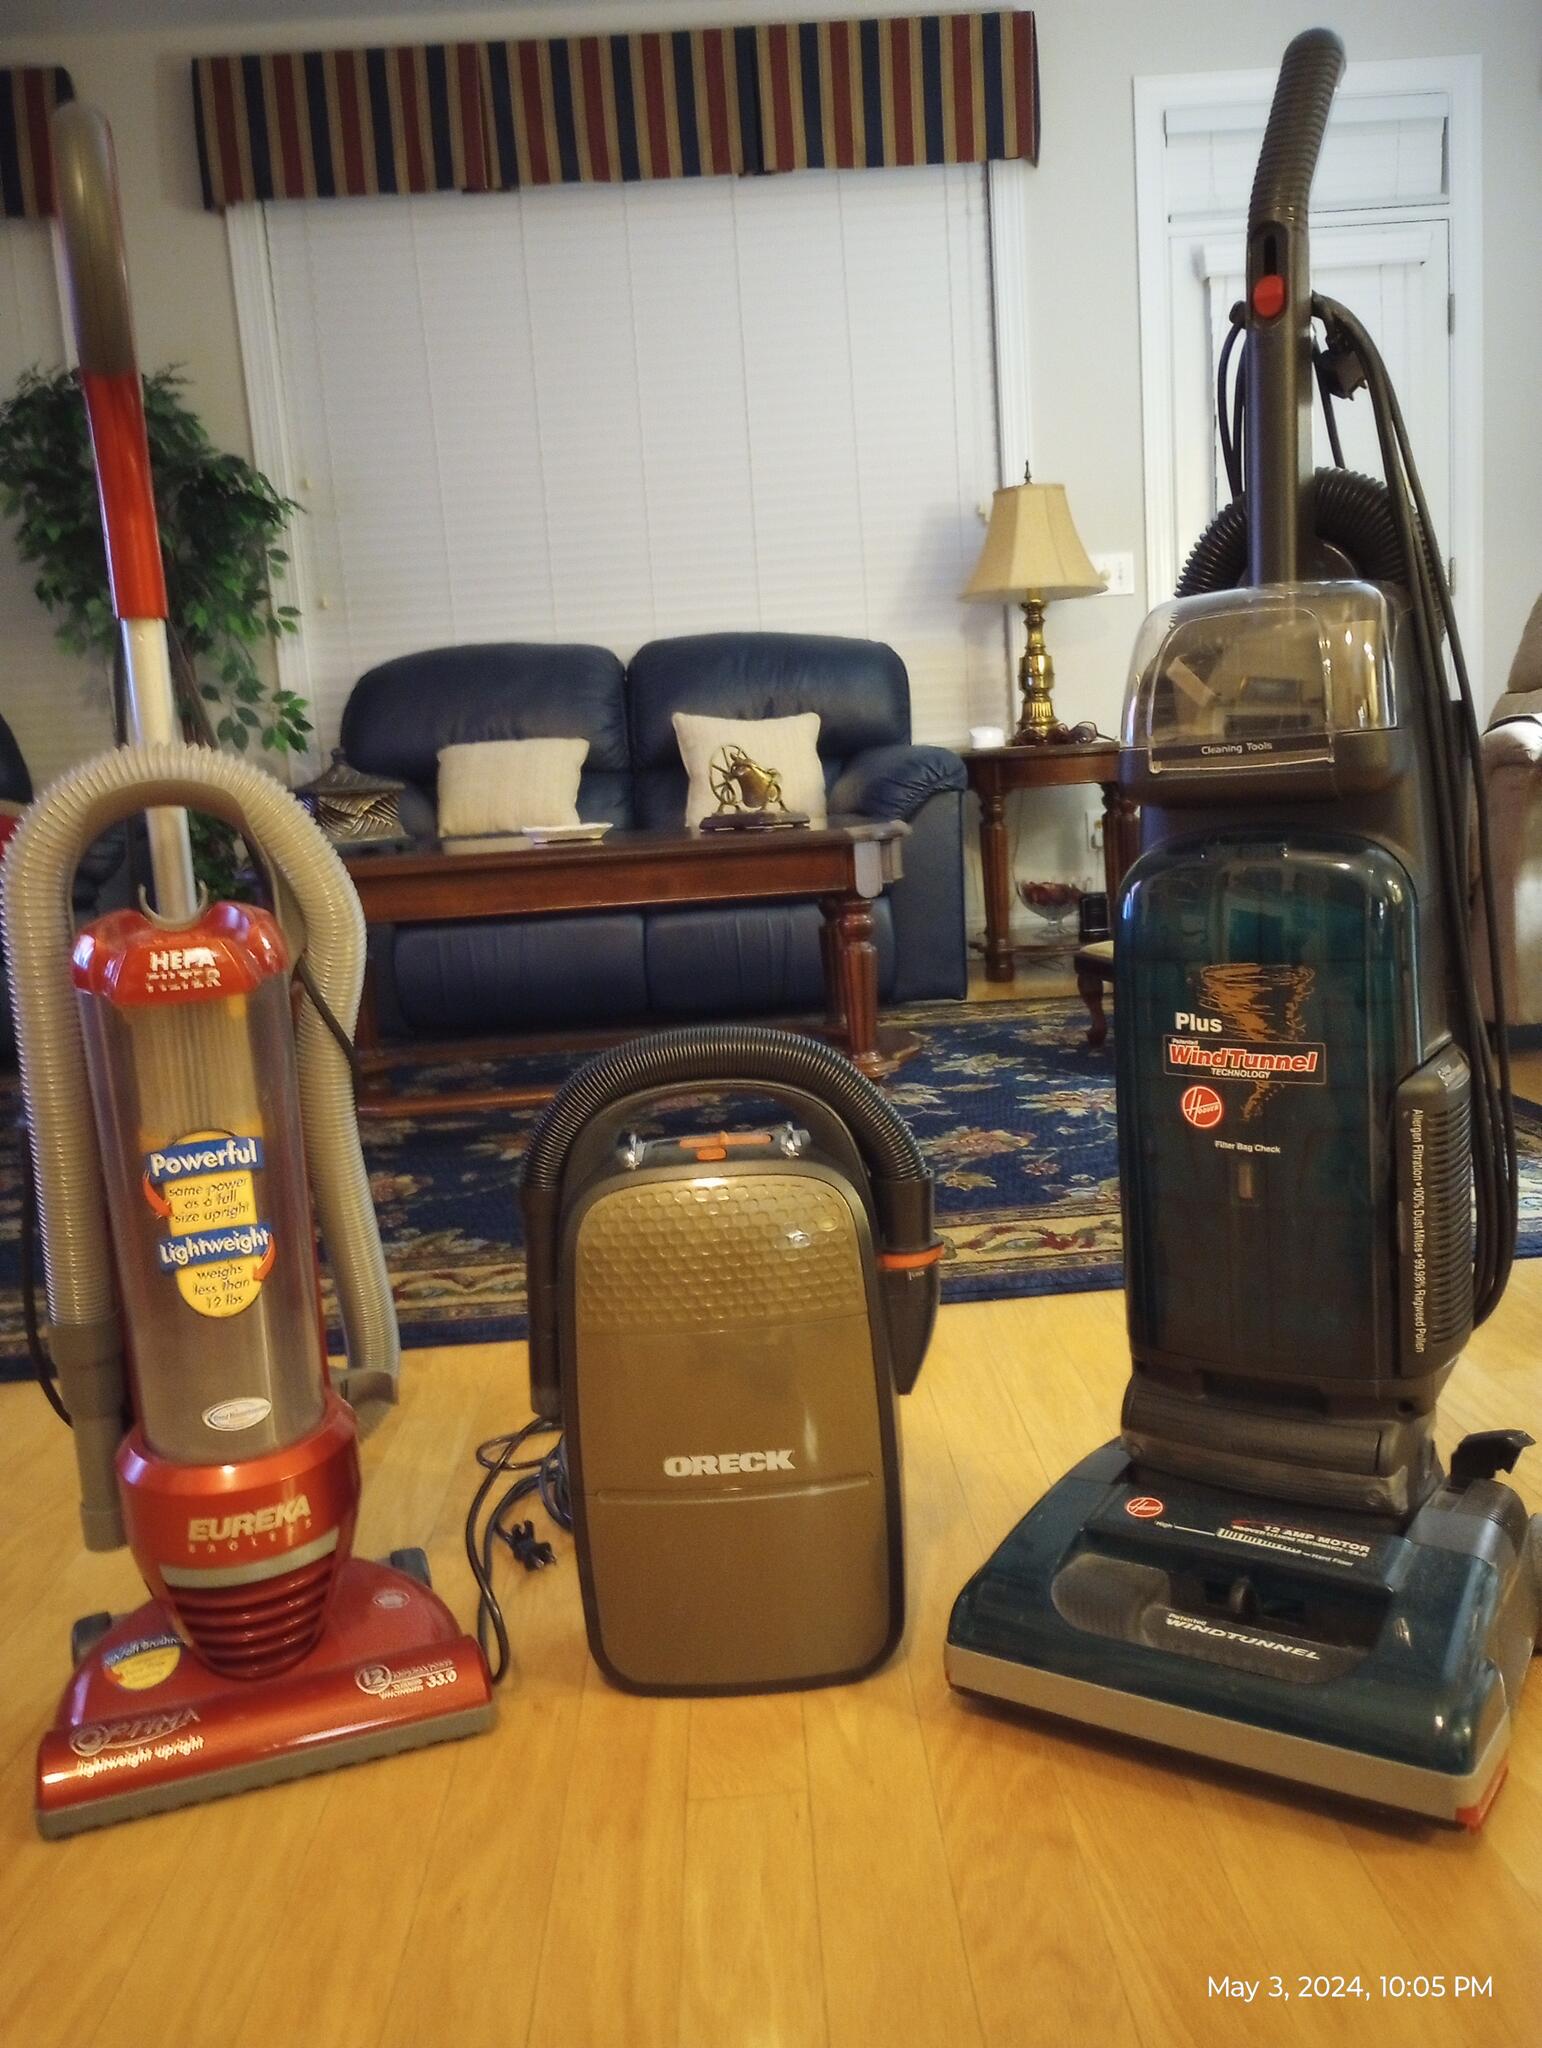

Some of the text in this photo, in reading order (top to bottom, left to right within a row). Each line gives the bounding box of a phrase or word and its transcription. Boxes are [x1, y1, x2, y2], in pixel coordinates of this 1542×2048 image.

[1201, 741, 1273, 755] Cleaning Tools
[150, 947, 216, 971] HEPA
[1175, 1012, 1223, 1033] Plus
[1169, 1043, 1318, 1073] WindTunnel
[1211, 1067, 1272, 1080] TECHNOLOGY
[1410, 1109, 1424, 1143] Allergen
[150, 1138, 258, 1177] Powerful
[1214, 1140, 1281, 1154] Filter Bag Check
[1412, 1144, 1425, 1181] Filtration
[169, 1176, 248, 1197] same power
[184, 1191, 237, 1209] as a full
[175, 1203, 249, 1223] size upright
[1412, 1209, 1425, 1229] Dust
[160, 1226, 270, 1265] Lightweight
[1413, 1230, 1426, 1253] Mites
[196, 1261, 244, 1280] weighs
[193, 1278, 249, 1296] less than
[207, 1293, 244, 1308] 12 lbs
[1412, 1289, 1427, 1327] Ragweed
[1414, 1328, 1427, 1353] Pollen
[663, 1450, 796, 1477] ORECK
[189, 1494, 311, 1541] EUREKA
[1282, 1529, 1315, 1540] AMP
[1318, 1536, 1371, 1553] MOTOR
[1166, 1617, 1320, 1660] WINDTUNNEL
[426, 1669, 457, 1688] 33.0
[154, 1734, 205, 1760] upright
